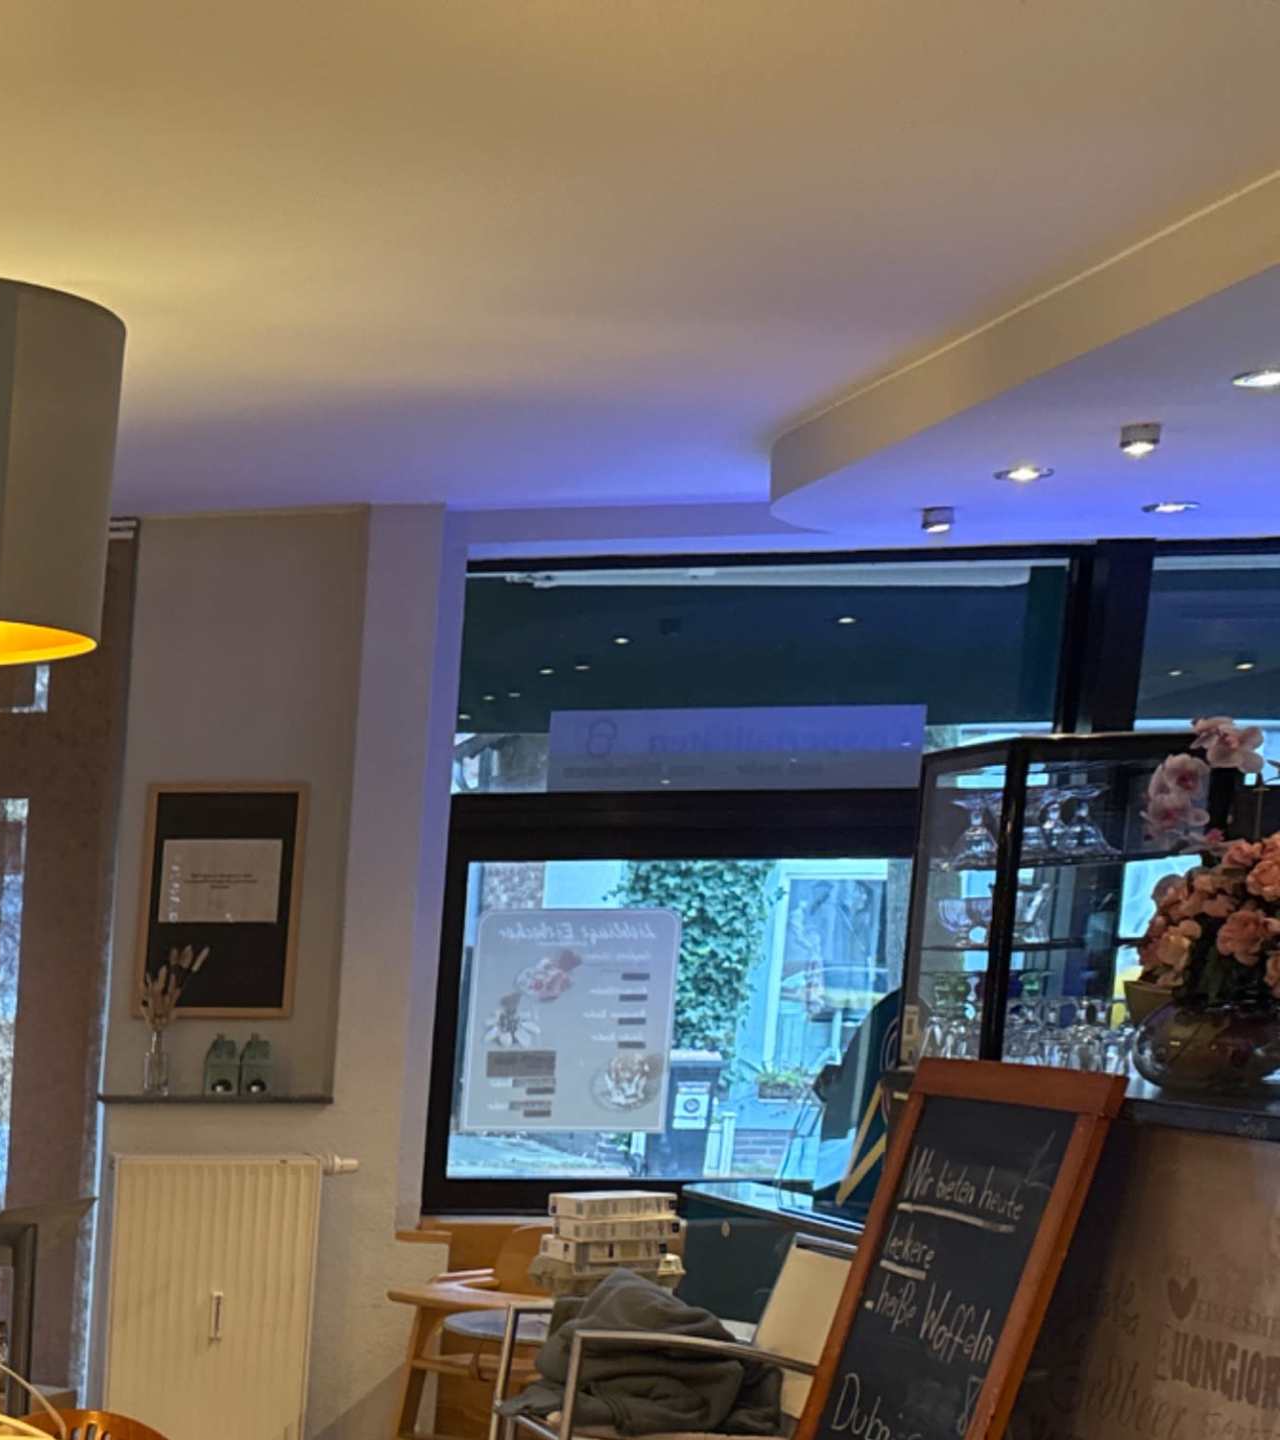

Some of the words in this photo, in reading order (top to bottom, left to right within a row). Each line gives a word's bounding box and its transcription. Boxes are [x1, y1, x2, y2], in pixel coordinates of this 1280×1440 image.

[904, 1146, 935, 1200] Wir
[936, 1160, 975, 1204] bieten
[979, 1166, 1025, 1221] heute
